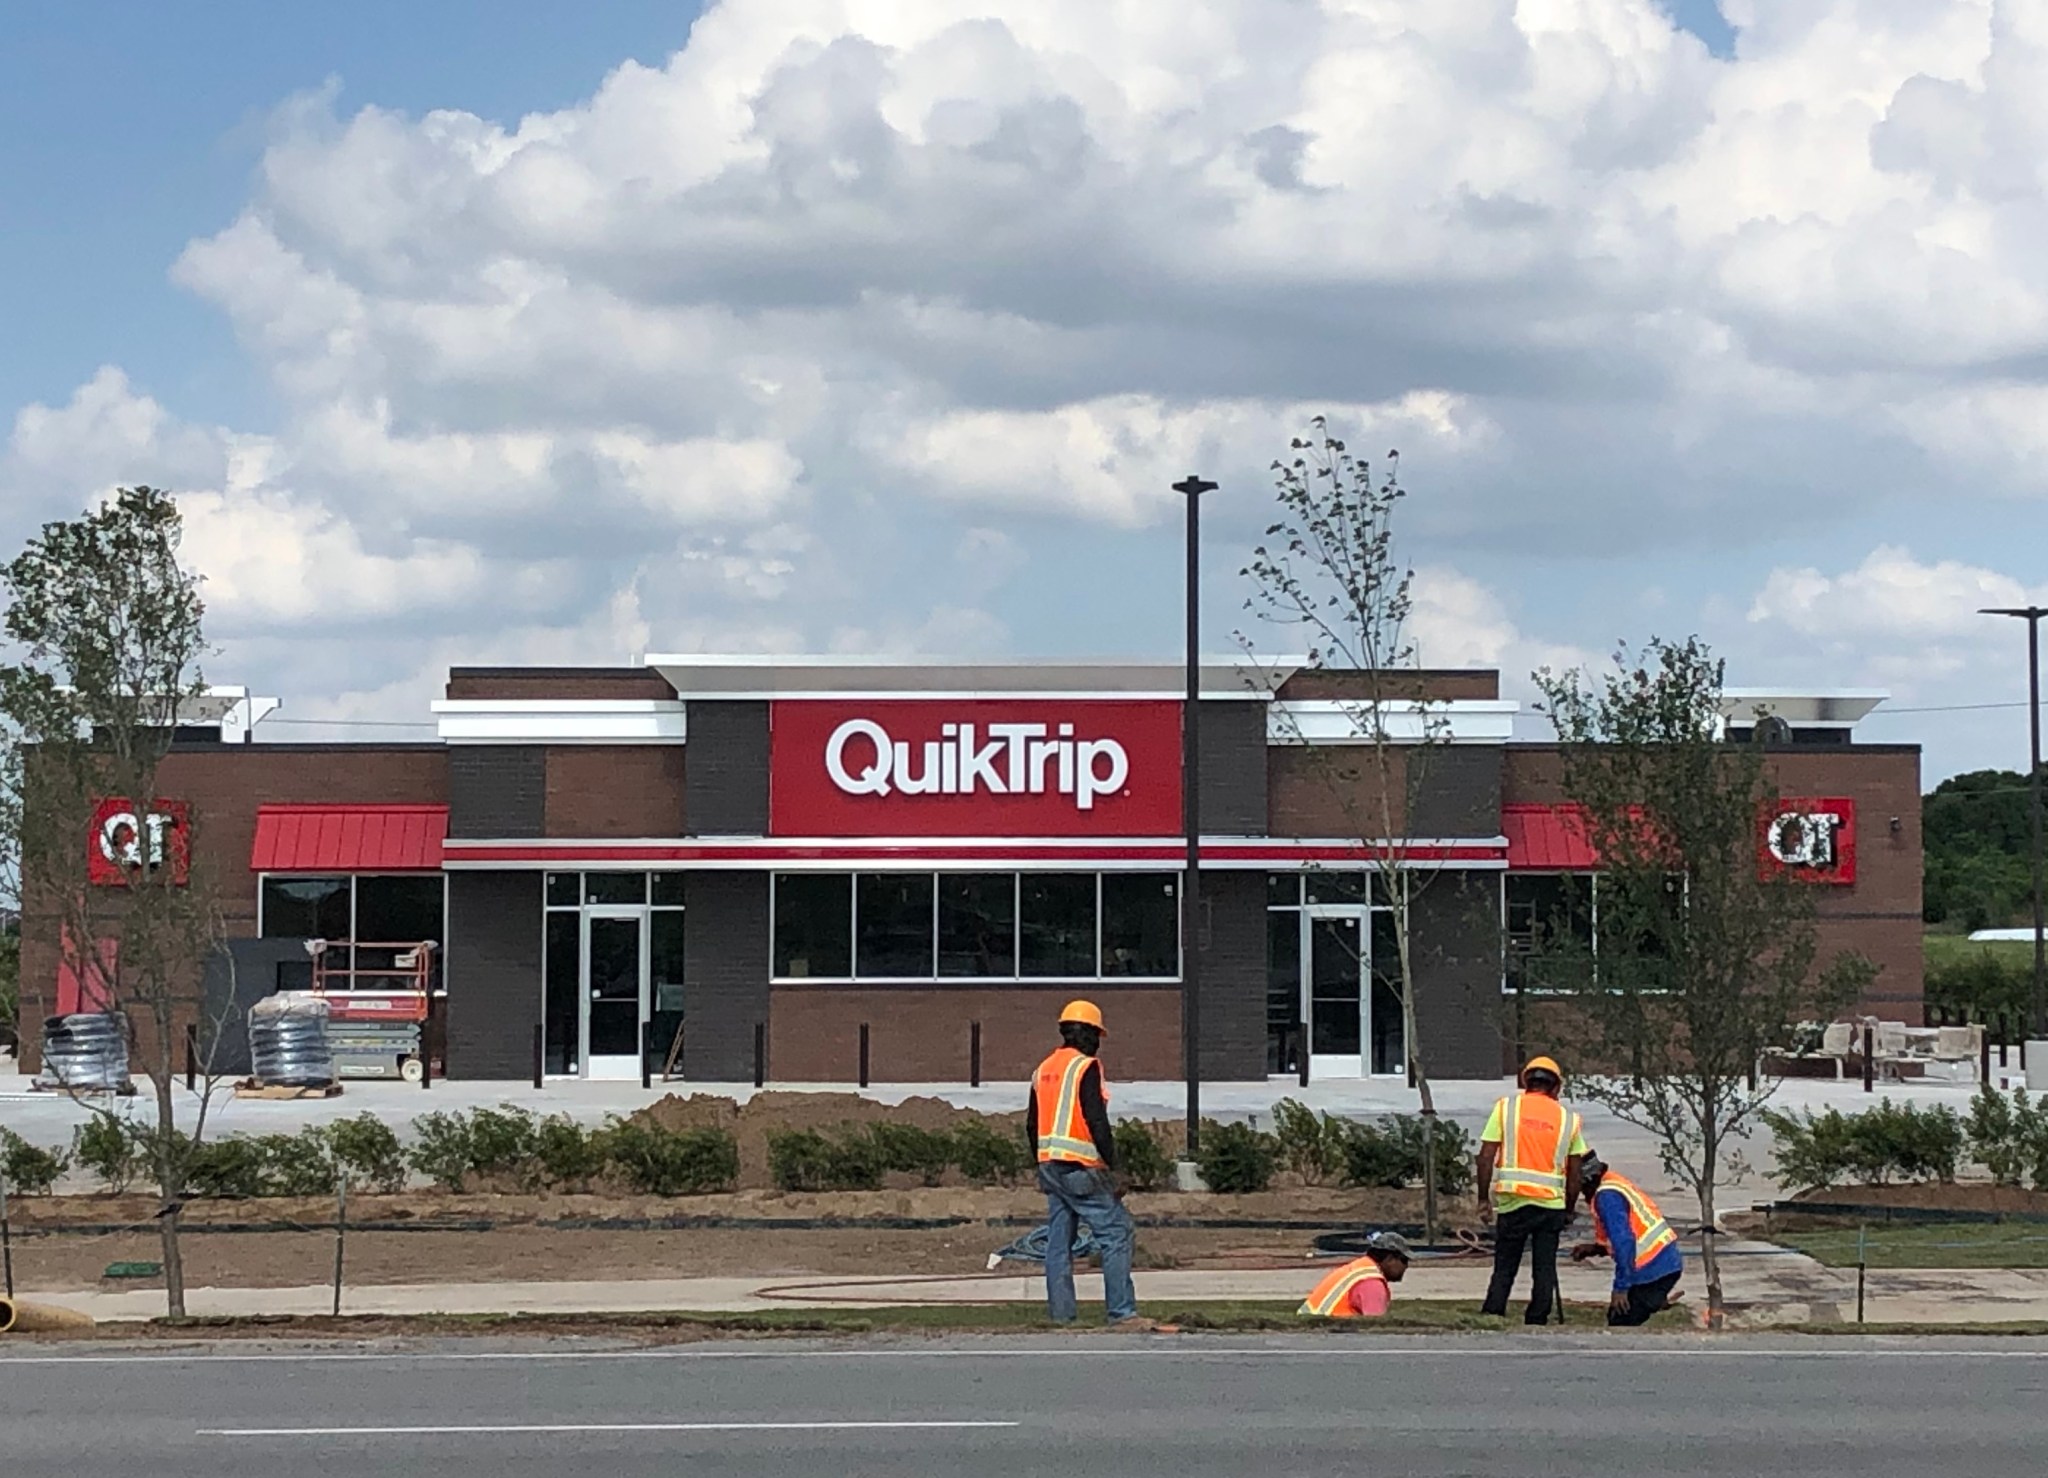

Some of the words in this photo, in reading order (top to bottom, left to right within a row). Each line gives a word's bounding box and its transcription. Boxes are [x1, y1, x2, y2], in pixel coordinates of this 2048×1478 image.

[825, 718, 1128, 809] QuikTrip
[99, 812, 172, 866] QT
[1767, 812, 1840, 867] QT
